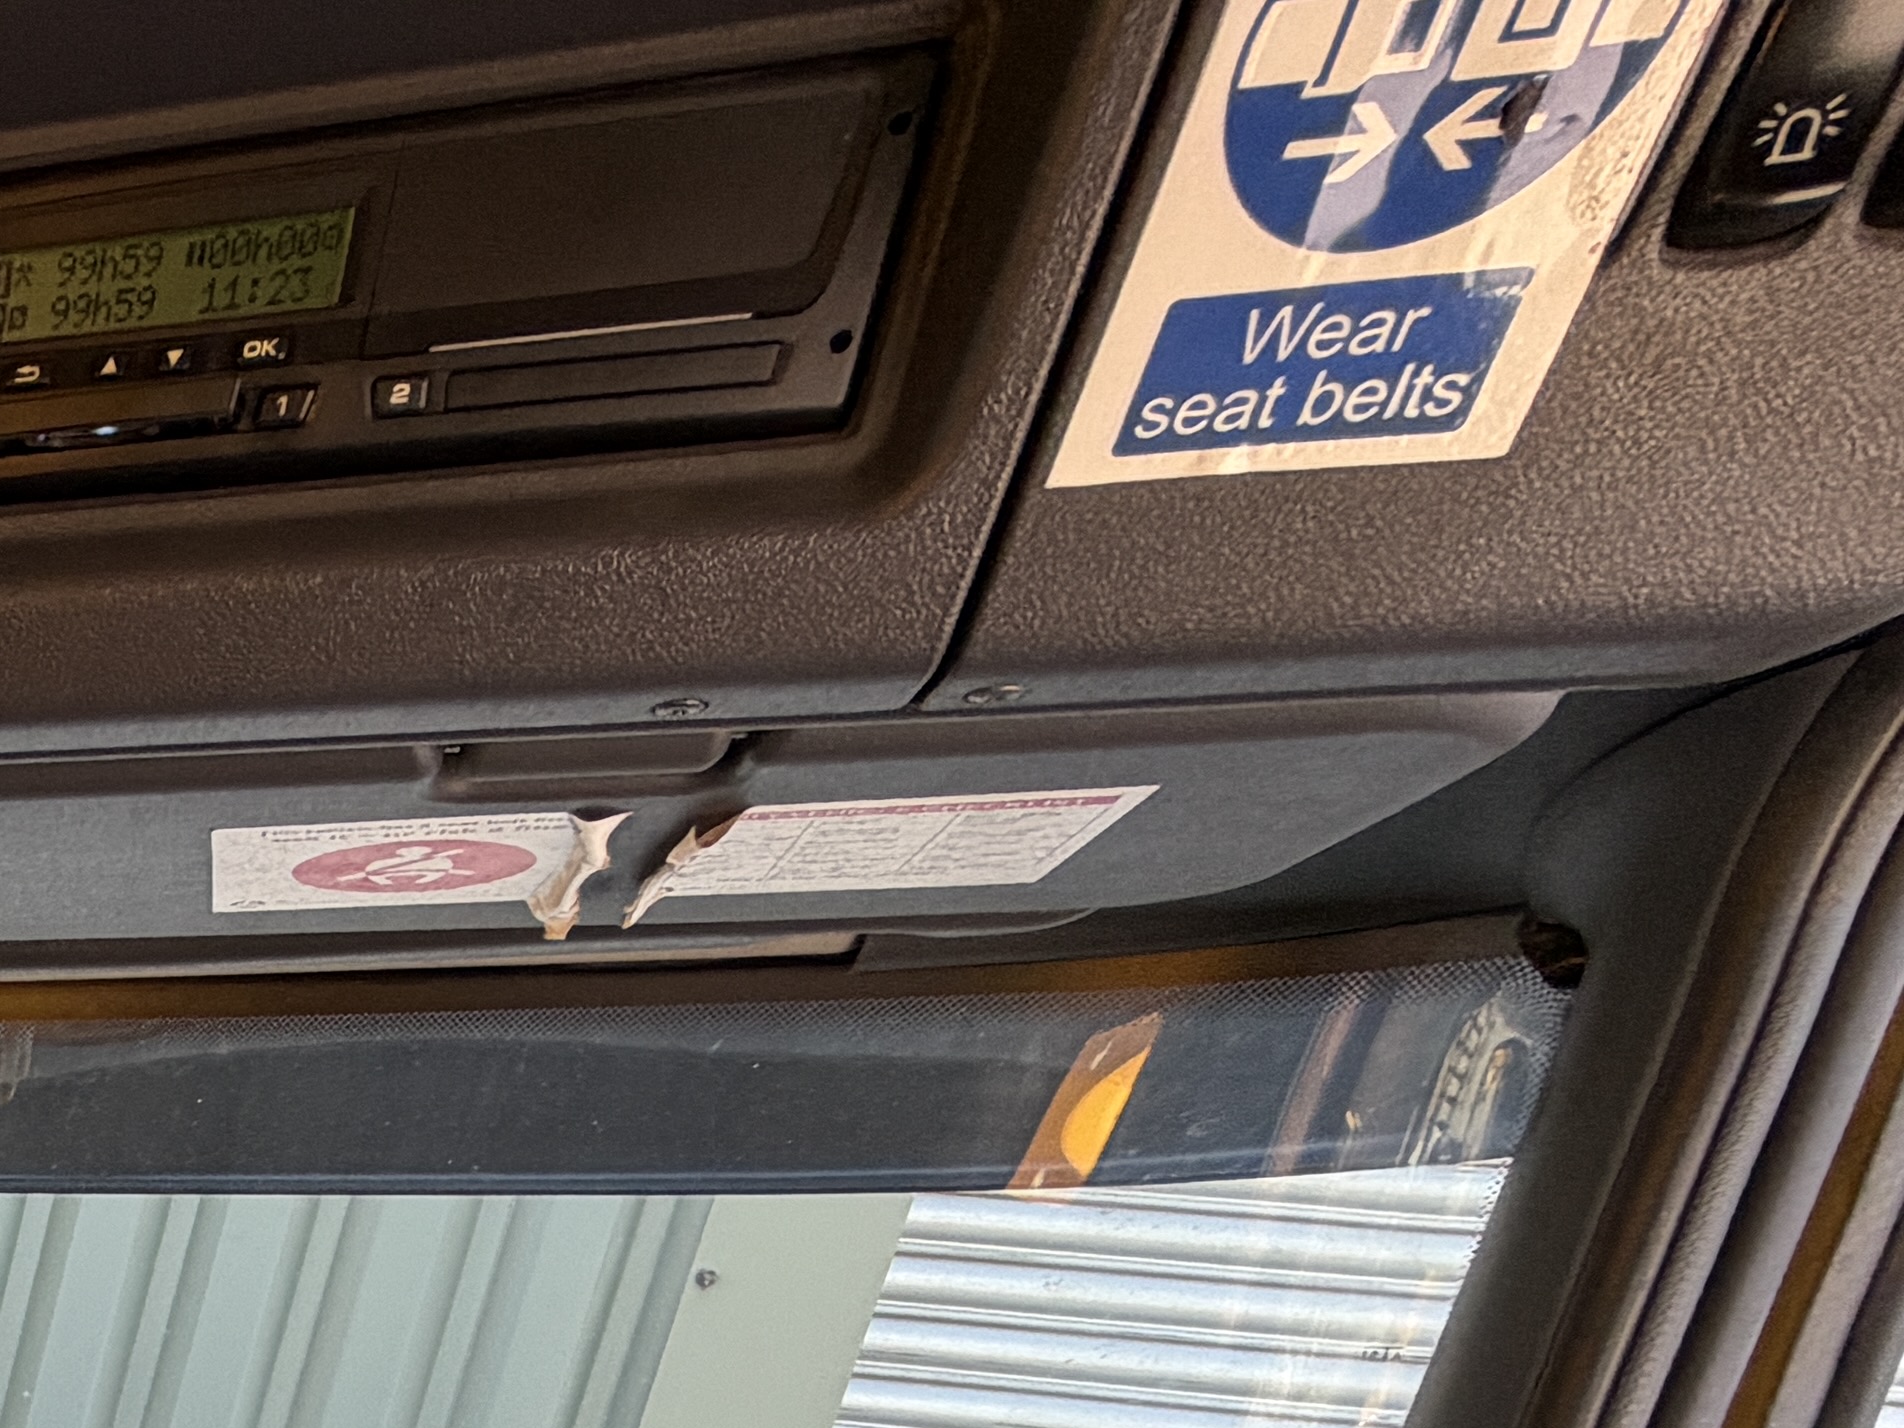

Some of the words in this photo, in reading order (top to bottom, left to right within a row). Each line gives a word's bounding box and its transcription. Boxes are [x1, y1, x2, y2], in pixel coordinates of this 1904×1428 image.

[58, 242, 163, 288] 99h59
[51, 285, 156, 331] 99h59
[199, 265, 314, 314] 11:23
[242, 337, 280, 359] OK
[1241, 303, 1430, 363] Wear
[389, 383, 410, 403] 2
[1134, 376, 1285, 439] seat
[1297, 363, 1471, 427] belts
